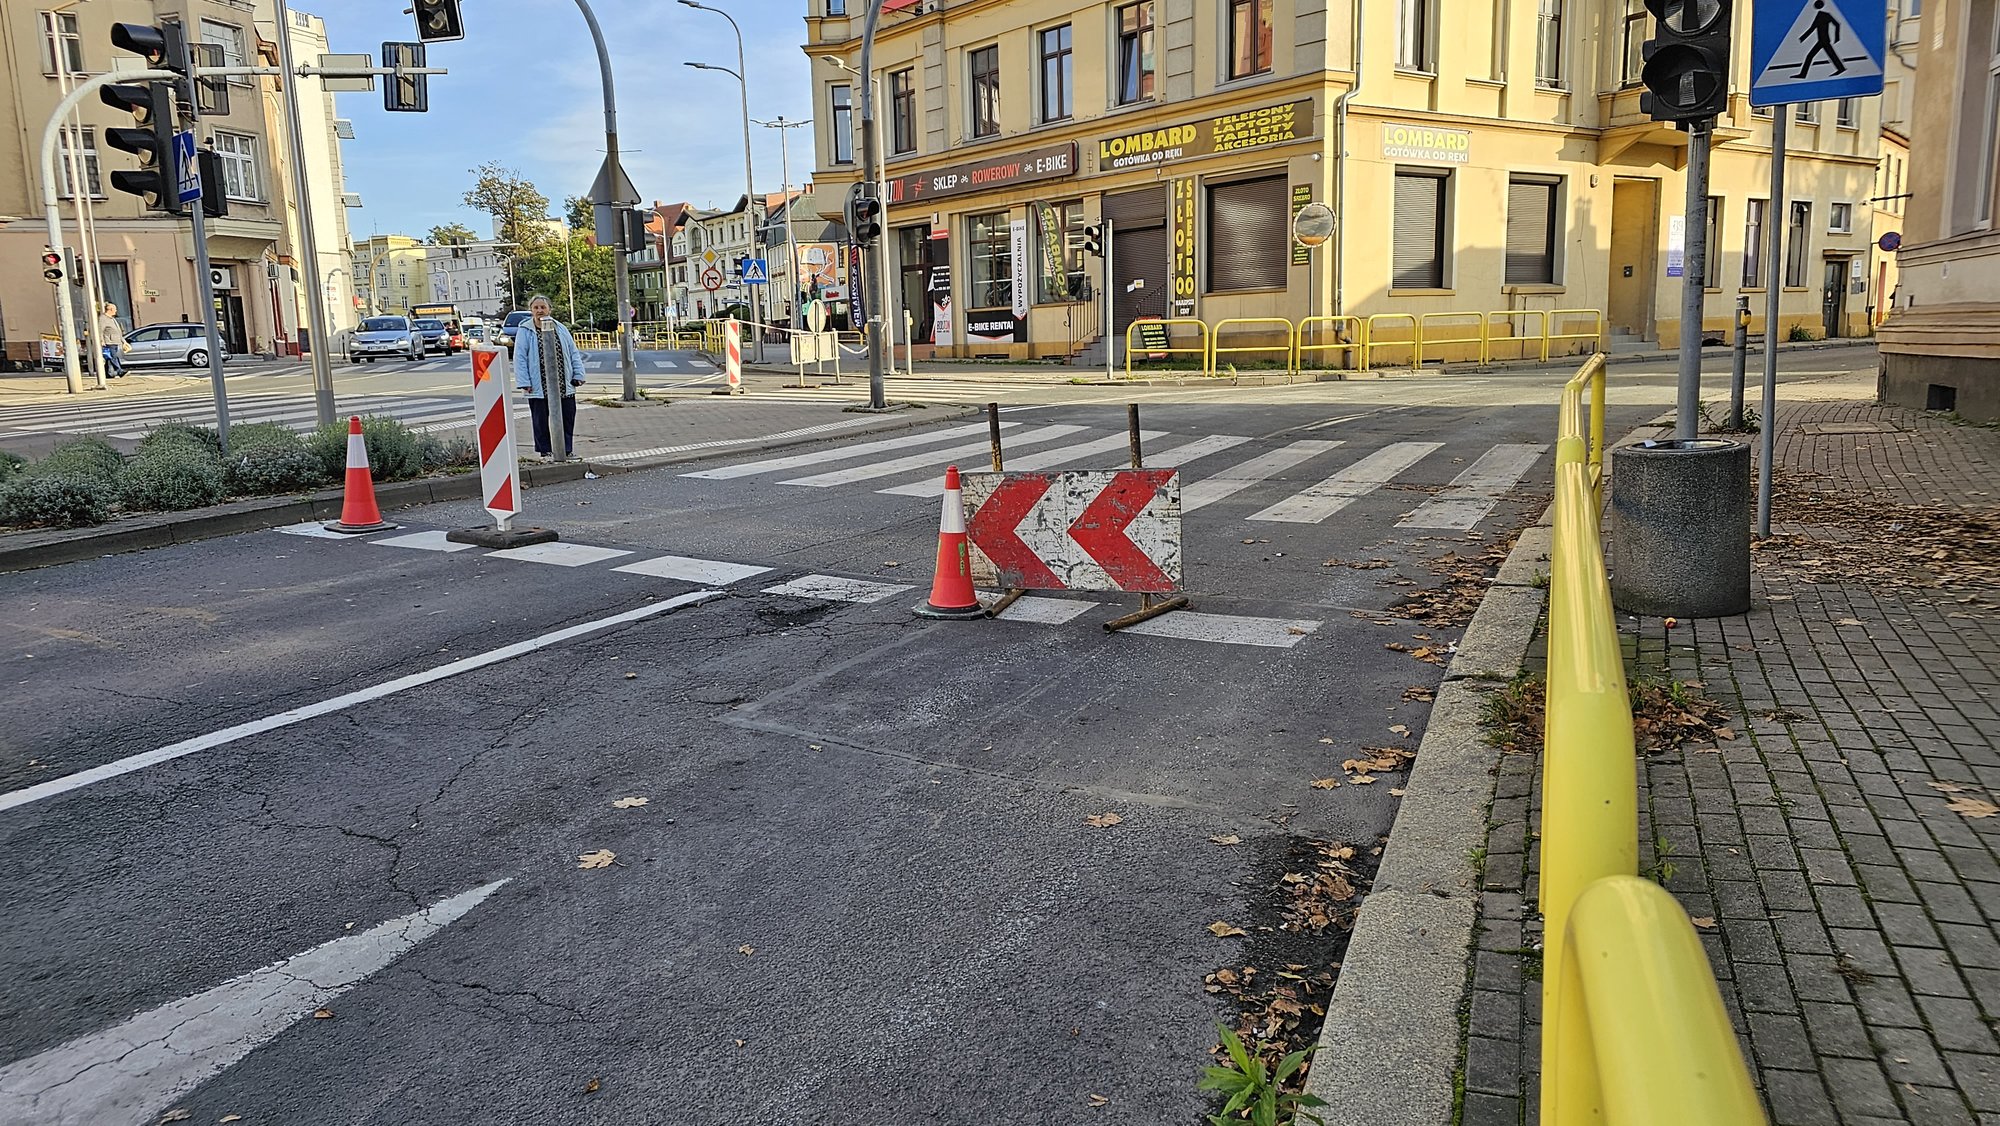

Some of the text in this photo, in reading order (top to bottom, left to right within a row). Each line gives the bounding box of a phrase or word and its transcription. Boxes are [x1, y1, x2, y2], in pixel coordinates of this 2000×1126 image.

[1213, 104, 1295, 127] TELEFONY
[1213, 112, 1295, 135] LAPTOPY
[1100, 124, 1197, 158] LOMBARD
[1213, 122, 1295, 143] TABLETY
[1213, 131, 1296, 151] AKCESORIA
[1384, 127, 1469, 150] LOMBARD
[1113, 147, 1183, 168] GOTÓWKA OD RĘKI
[1384, 146, 1469, 163] GOTÓWKA OD RĘKI
[877, 154, 1067, 203] BLTON SKLEP ROWEROWY E-BIKE
[1185, 179, 1195, 295] SREBRO
[968, 322, 989, 332] E-BIKE
